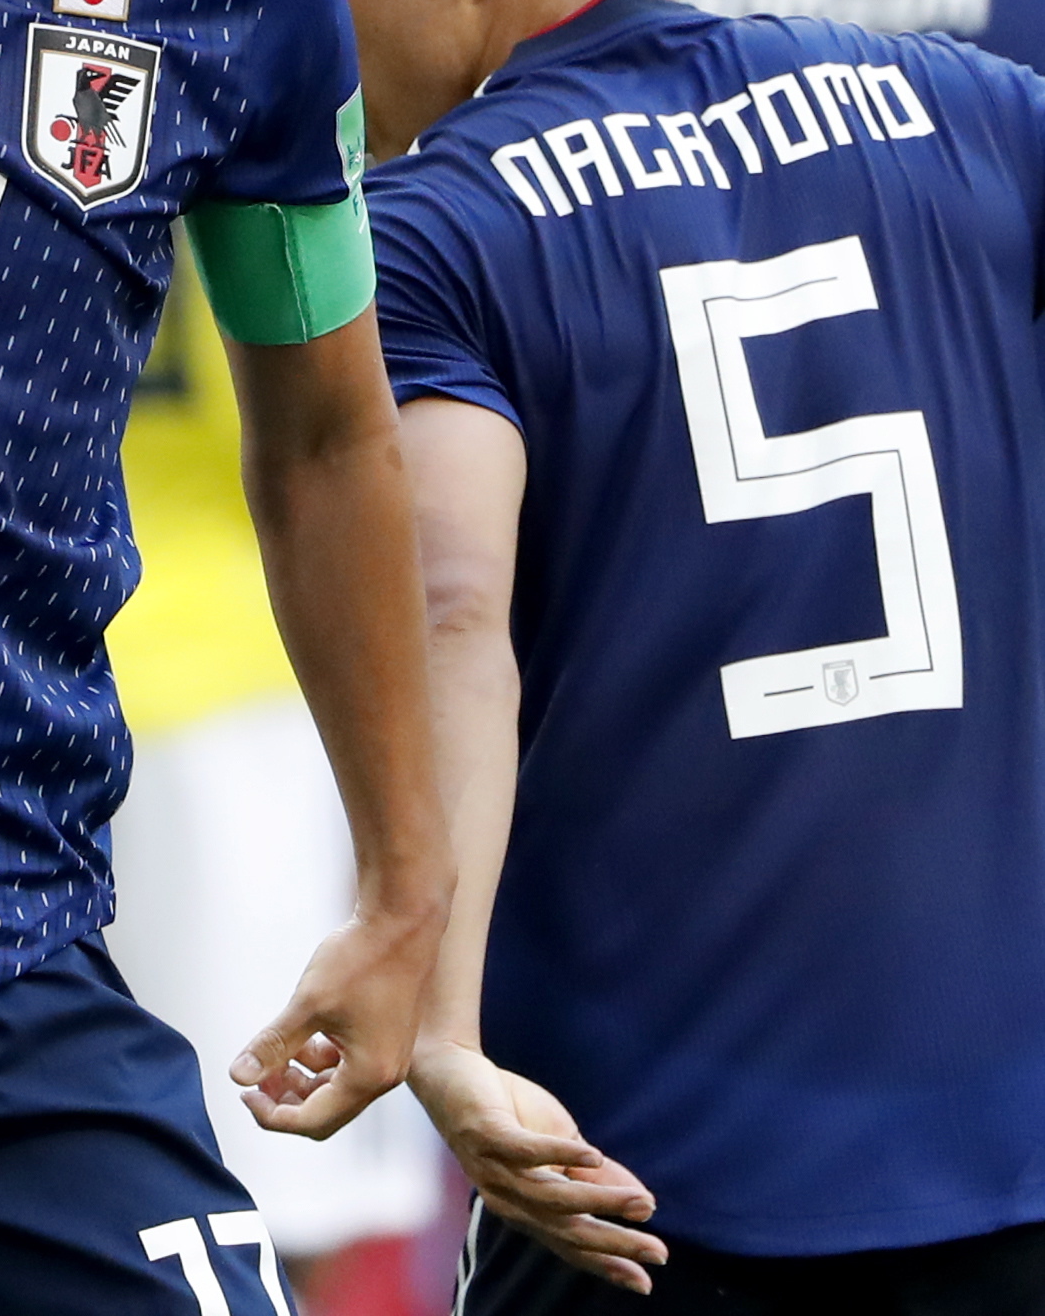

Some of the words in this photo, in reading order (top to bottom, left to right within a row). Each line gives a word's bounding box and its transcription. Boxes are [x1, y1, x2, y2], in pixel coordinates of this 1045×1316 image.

[65, 36, 130, 61] JAPAN
[61, 146, 112, 181] JFA
[490, 62, 936, 217] NAGATOMO
[659, 234, 963, 740] 5
[138, 1209, 291, 1316] 17
